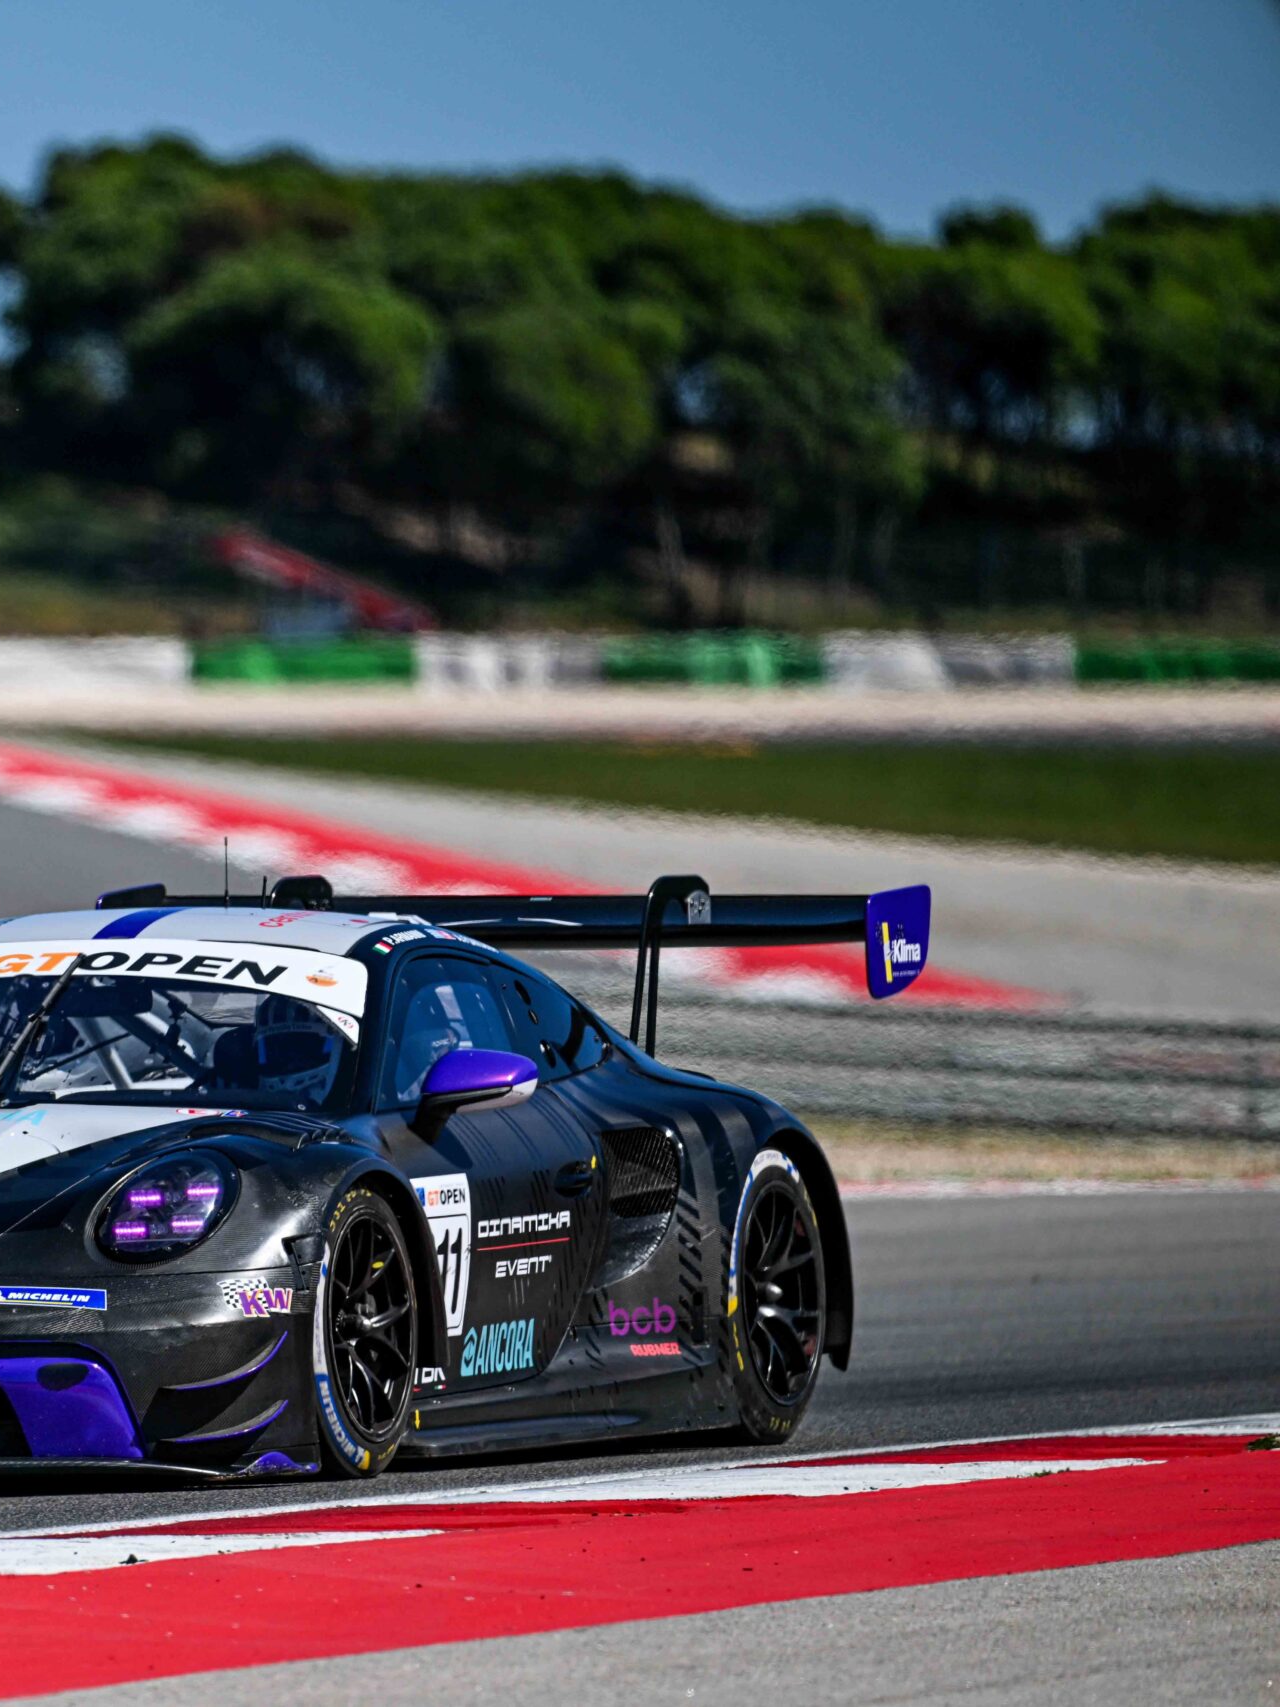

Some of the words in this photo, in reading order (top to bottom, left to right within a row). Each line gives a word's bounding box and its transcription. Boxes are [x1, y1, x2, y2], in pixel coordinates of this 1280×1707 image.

[477, 1210, 571, 1238] DINAMIKA
[495, 1255, 550, 1278] EVENT
[7, 1291, 91, 1303] MICHELIN
[238, 1287, 294, 1318] KW
[608, 1296, 677, 1337] bcb
[474, 1318, 535, 1376] ANCORA
